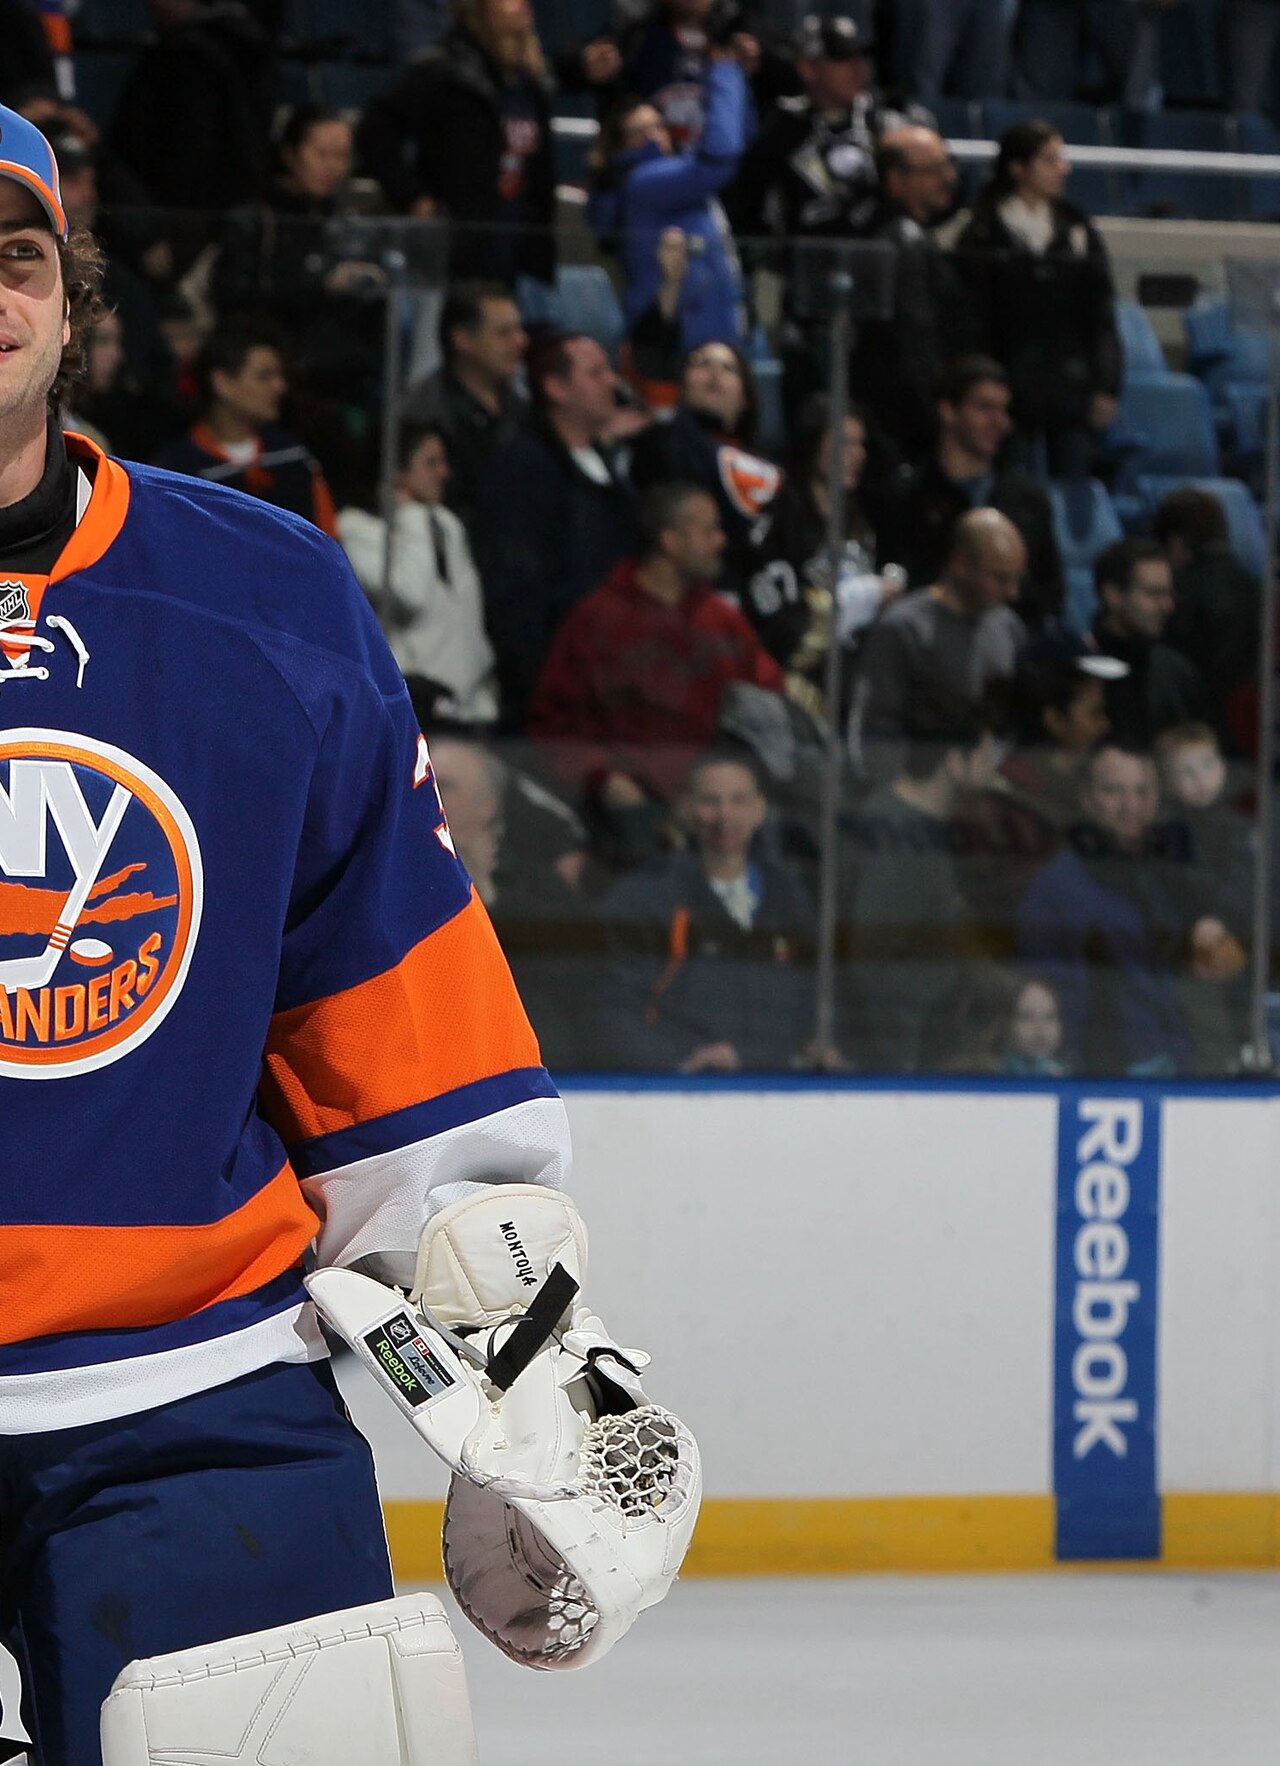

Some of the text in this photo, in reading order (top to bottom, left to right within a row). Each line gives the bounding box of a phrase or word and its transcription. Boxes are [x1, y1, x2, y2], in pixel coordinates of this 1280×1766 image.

[0, 591, 23, 617] NHL
[499, 1220, 538, 1287] MONTOYA
[1070, 1099, 1145, 1460] Reebok
[375, 1339, 418, 1392] Reebok
